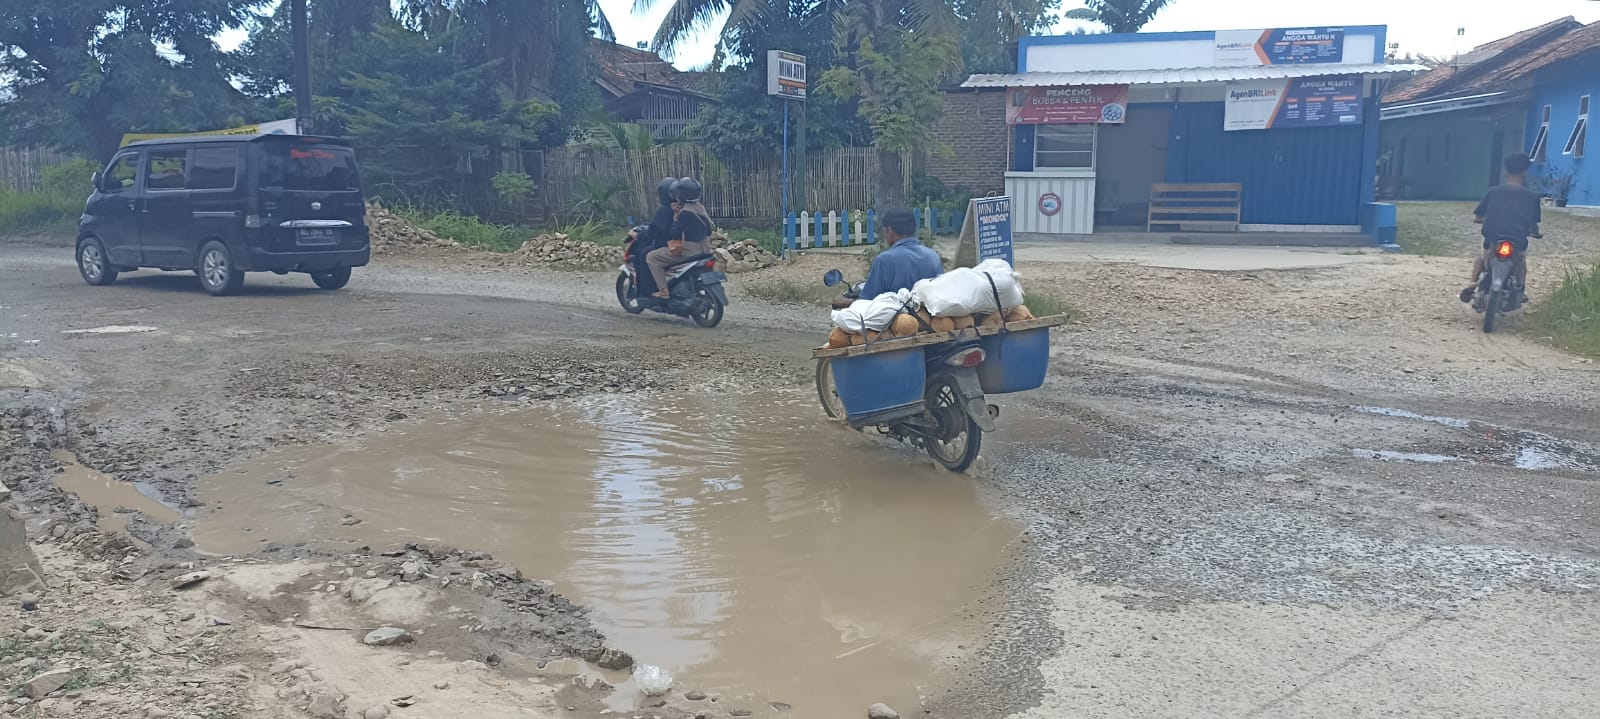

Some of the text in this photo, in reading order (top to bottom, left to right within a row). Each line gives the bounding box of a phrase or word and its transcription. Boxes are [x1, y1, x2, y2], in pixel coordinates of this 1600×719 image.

[1230, 88, 1277, 99] AgenBRILink
[1032, 97, 1060, 105] BOBBA
[1070, 96, 1105, 104] PENTOL
[978, 200, 1010, 215] MINI ATM
